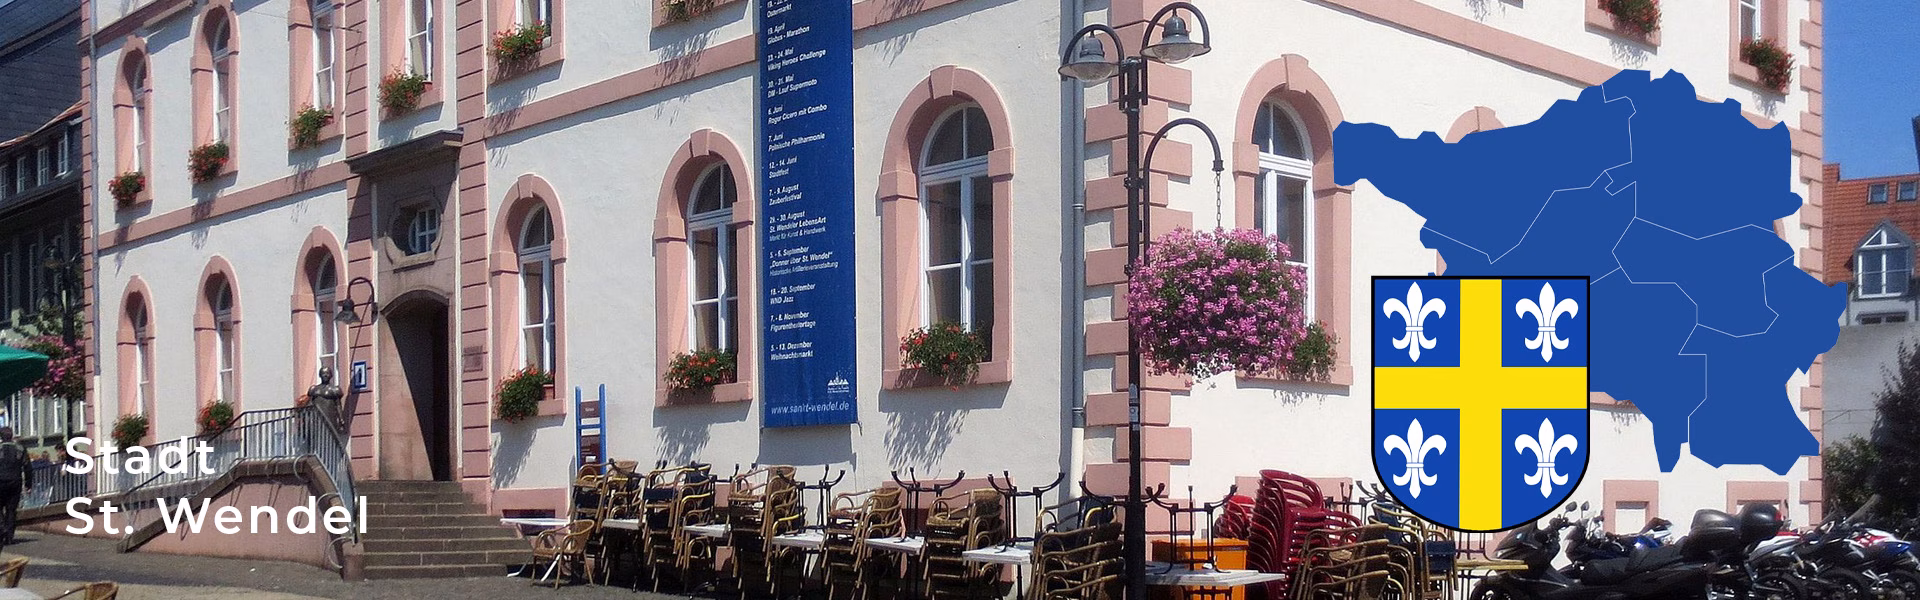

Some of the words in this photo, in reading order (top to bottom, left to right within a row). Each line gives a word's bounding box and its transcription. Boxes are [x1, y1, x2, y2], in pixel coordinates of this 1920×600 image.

[767, 4, 792, 17] Ostermarkt
[774, 23, 785, 33] April
[768, 35, 783, 44] Globus
[786, 26, 810, 38] Marathon
[785, 47, 794, 55] Mai
[768, 62, 781, 71] Viking
[782, 56, 798, 66] Heroes
[799, 50, 826, 61] Challenge
[786, 74, 794, 82] Mai
[779, 85, 789, 95] Lauf
[790, 79, 817, 91] Supermoto
[768, 116, 782, 124] Roger
[782, 111, 798, 121] Cicero
[798, 108, 807, 116] mit
[808, 104, 827, 114] Combo
[773, 104, 783, 114] Juni
[768, 141, 790, 152] Polnische
[791, 132, 825, 145] Philharmonie
[774, 133, 783, 141] Juni
[787, 156, 797, 164] Juni
[769, 168, 789, 178] Stadtfest
[782, 184, 799, 193] August
[769, 192, 802, 206] Zauberfestival
[787, 211, 805, 220] August
[777, 222, 798, 231] Wendeler
[799, 217, 826, 227] LebensArt
[804, 226, 826, 235] Handwerk
[783, 246, 809, 256] September
[789, 283, 815, 293] September
[784, 312, 809, 320] November
[770, 321, 816, 332] Figurentheatertage
[787, 341, 812, 350] Dezember
[771, 350, 814, 360] Weihnachtsmarkt
